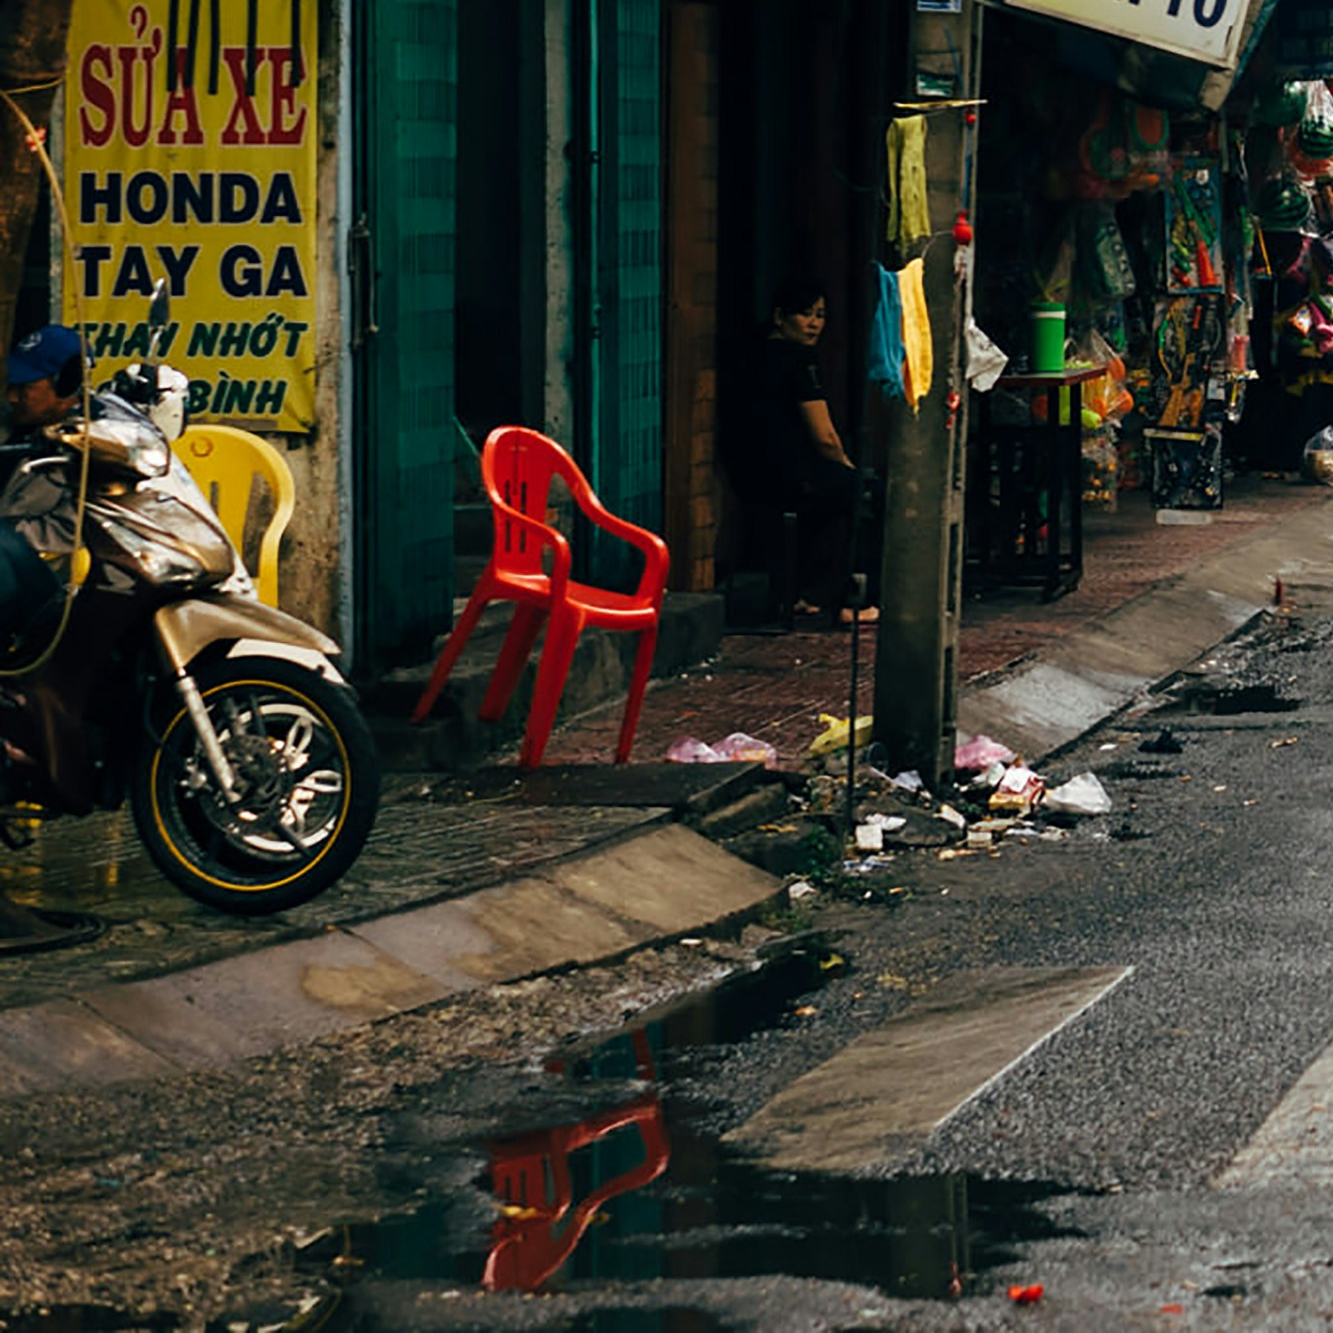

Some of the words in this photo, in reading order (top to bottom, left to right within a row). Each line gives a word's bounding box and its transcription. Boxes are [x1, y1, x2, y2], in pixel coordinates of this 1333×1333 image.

[79, 5, 204, 148] SỬA
[221, 45, 308, 147] XE
[79, 171, 303, 225] HONDA
[75, 245, 200, 298] TAY
[218, 245, 309, 298] GA
[186, 312, 309, 359] NHỚT
